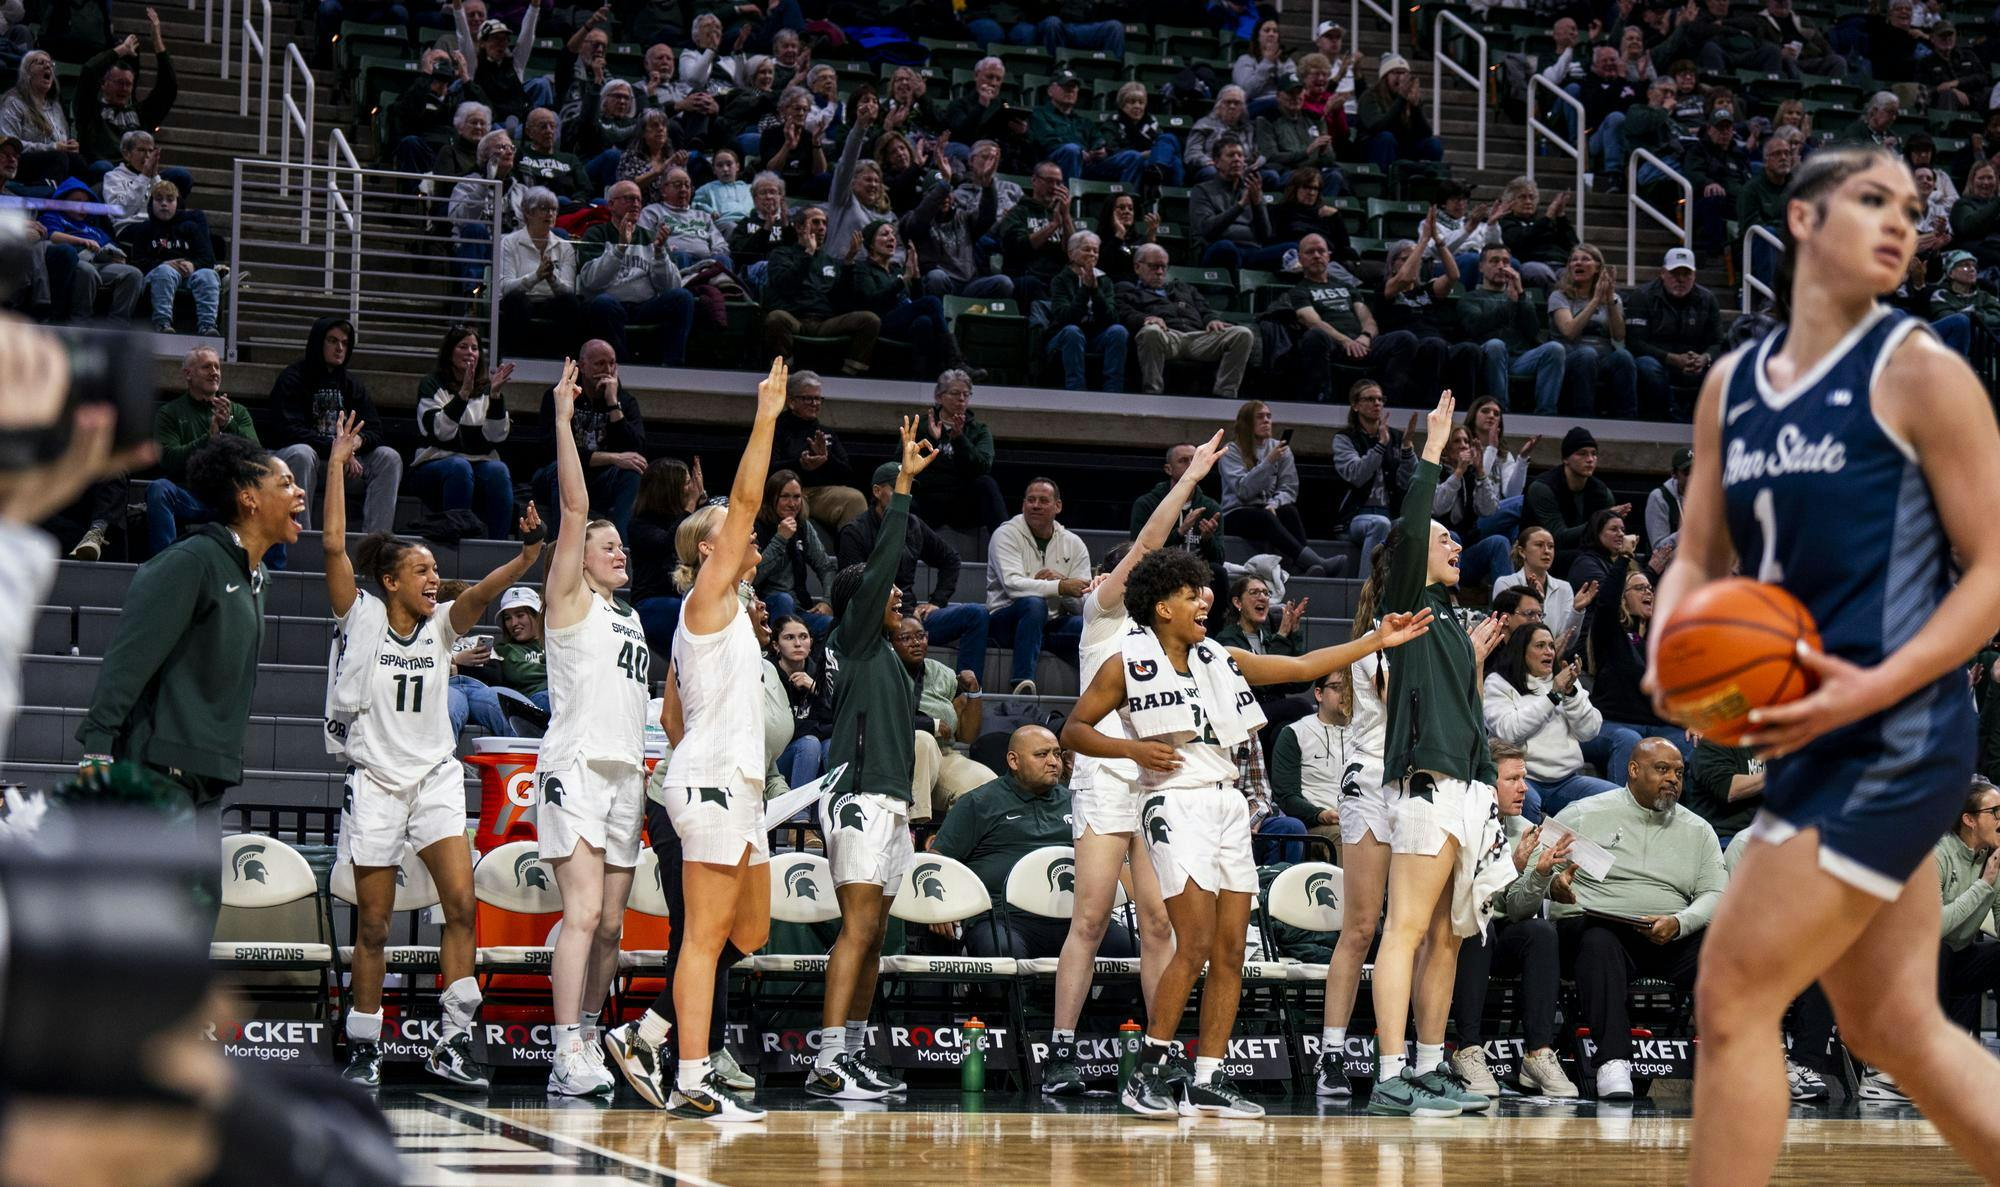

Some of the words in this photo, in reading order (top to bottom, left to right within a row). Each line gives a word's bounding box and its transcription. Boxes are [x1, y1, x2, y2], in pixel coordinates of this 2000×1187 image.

[1310, 288, 1350, 301] MSU
[1766, 423, 1847, 477] State
[1754, 487, 1784, 584] 1
[612, 622, 646, 644] SPARTAN
[379, 654, 434, 669] SPARTANS
[617, 641, 649, 685] 40
[393, 673, 424, 713] 11
[234, 947, 304, 960] SPARTANS
[392, 950, 440, 964] SPARTA
[793, 959, 826, 972] SPAR
[929, 961, 993, 973] SPARTANS
[224, 1044, 300, 1061] Mortgage
[383, 1041, 432, 1058] Mortg
[512, 1047, 556, 1063] Mortg
[918, 1049, 964, 1065] Mortg
